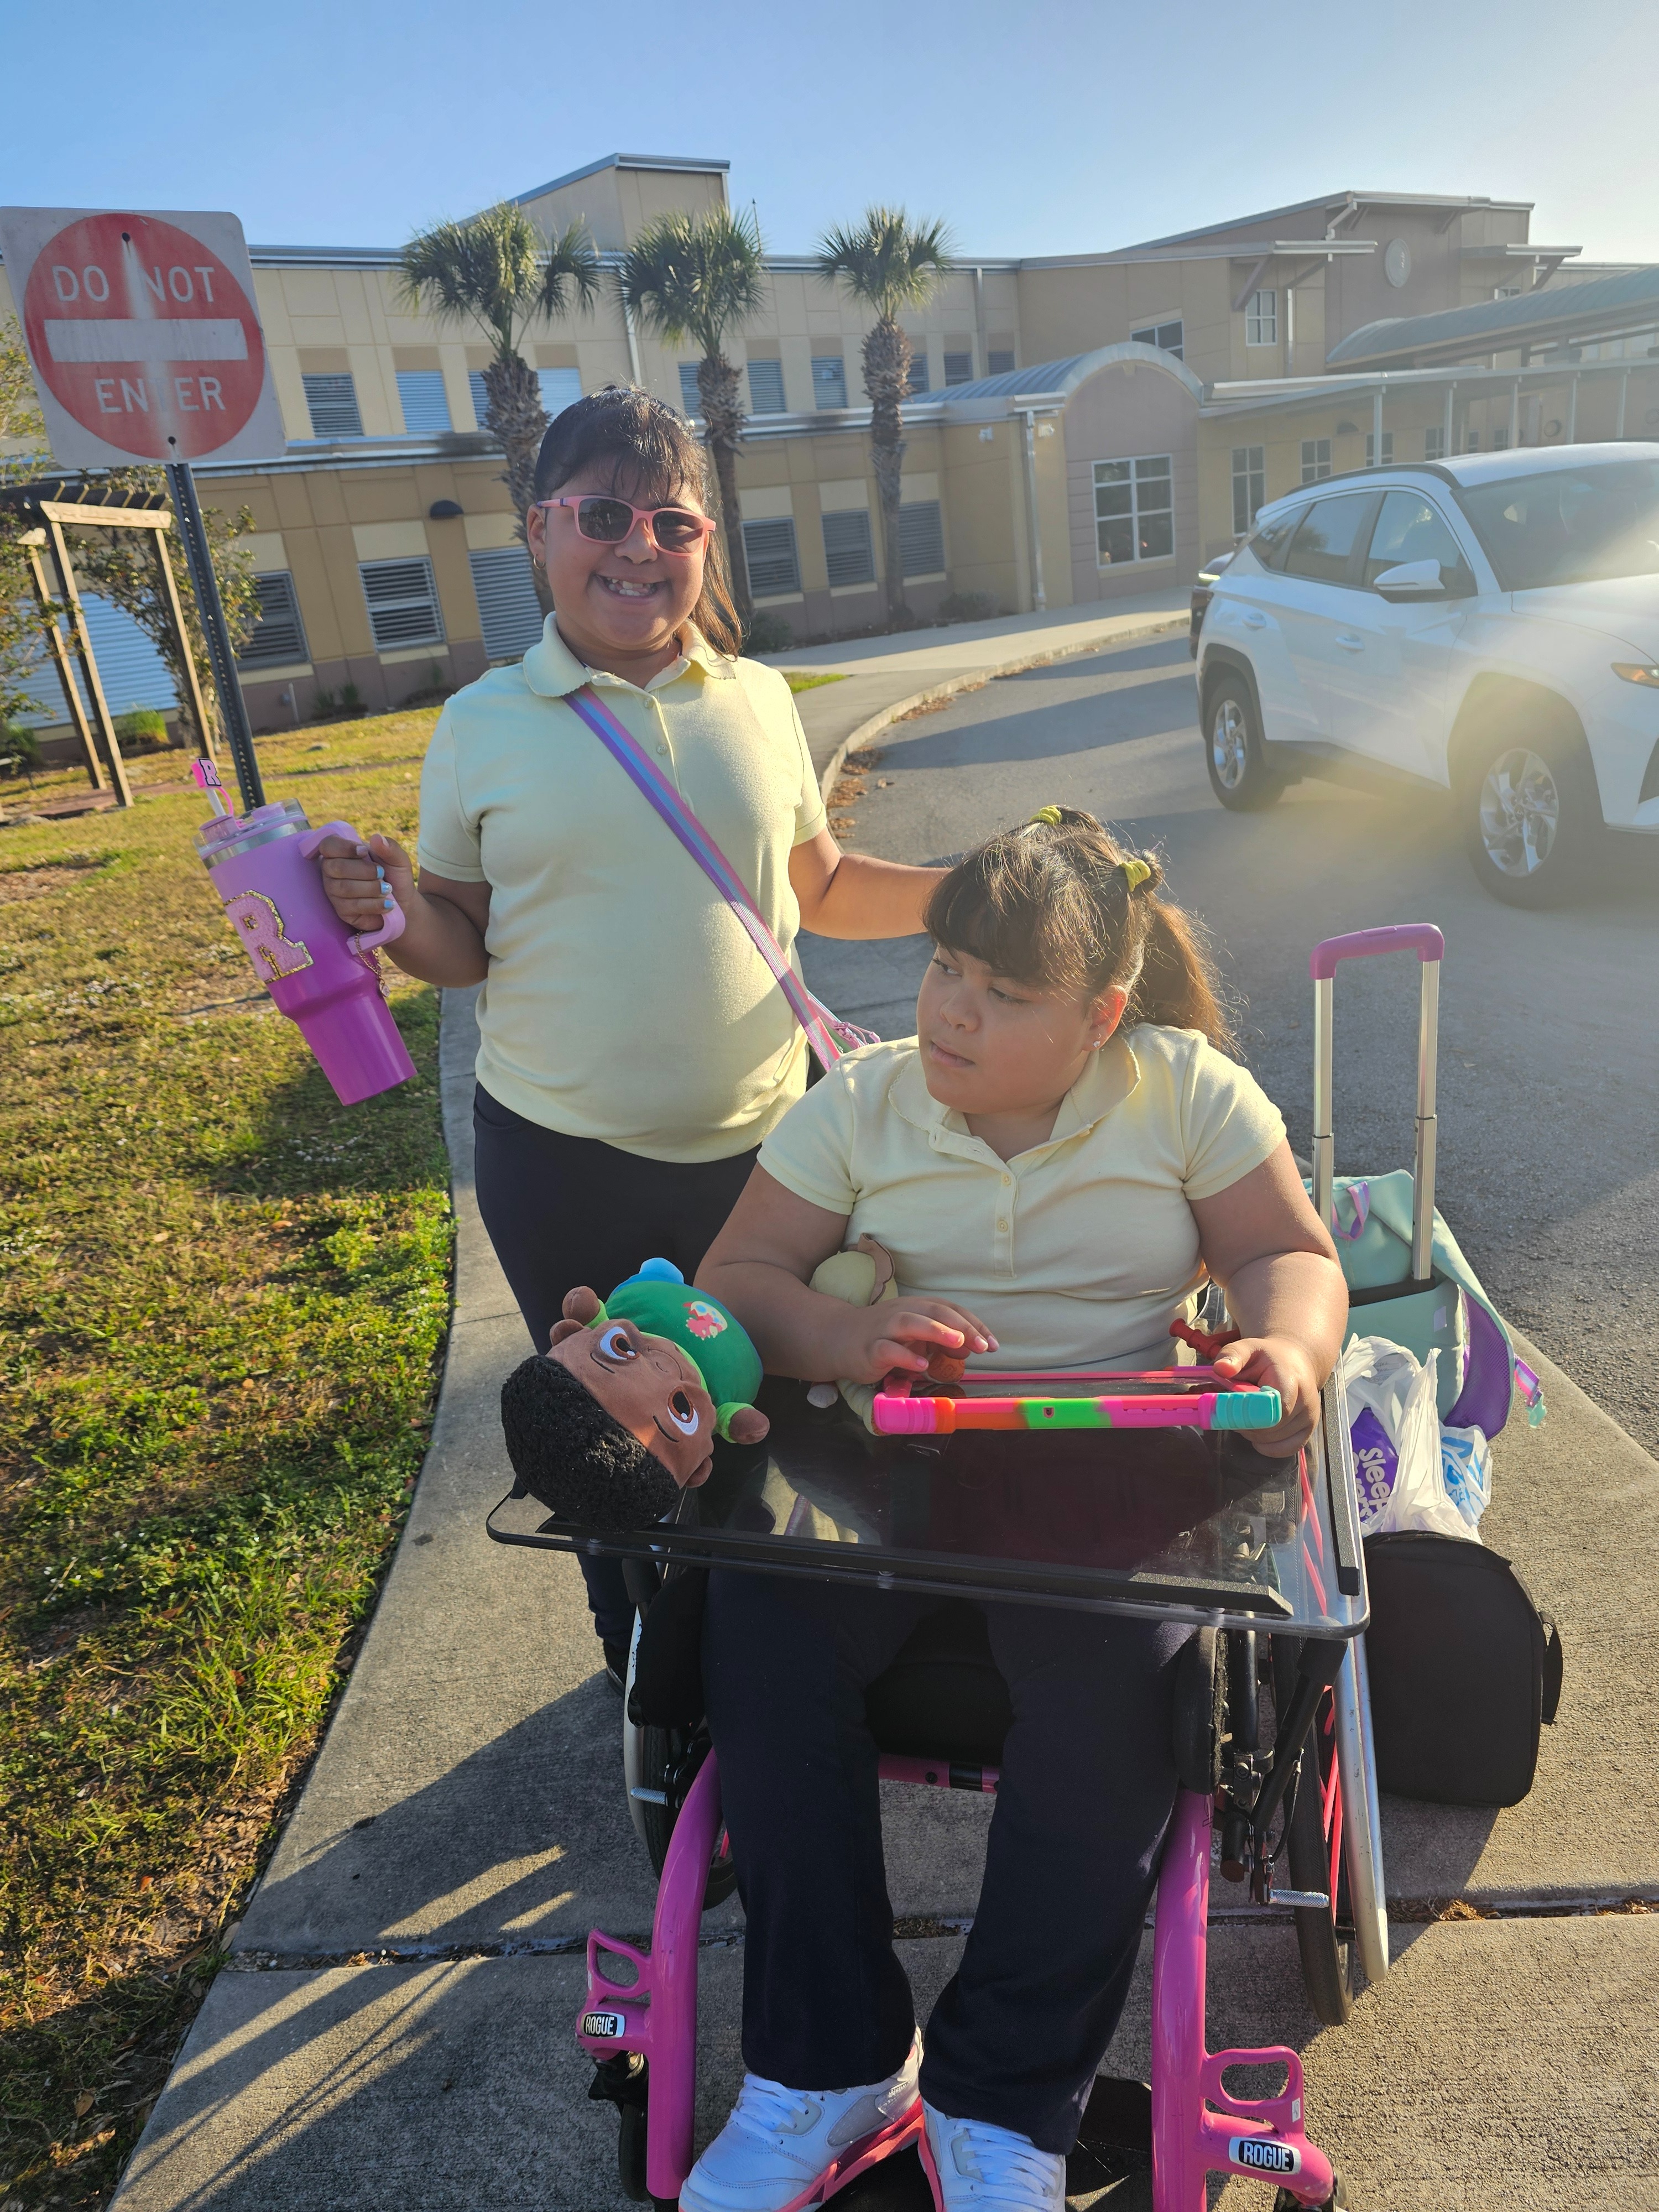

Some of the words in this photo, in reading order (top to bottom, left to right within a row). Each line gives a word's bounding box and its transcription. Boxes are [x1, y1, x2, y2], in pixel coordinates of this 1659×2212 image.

[52, 265, 109, 302] DO
[137, 266, 215, 302] NOT
[198, 758, 222, 786] R
[223, 889, 314, 983] R
[585, 2016, 614, 2035] ROGUE
[1243, 2142, 1290, 2171] ROGUE
